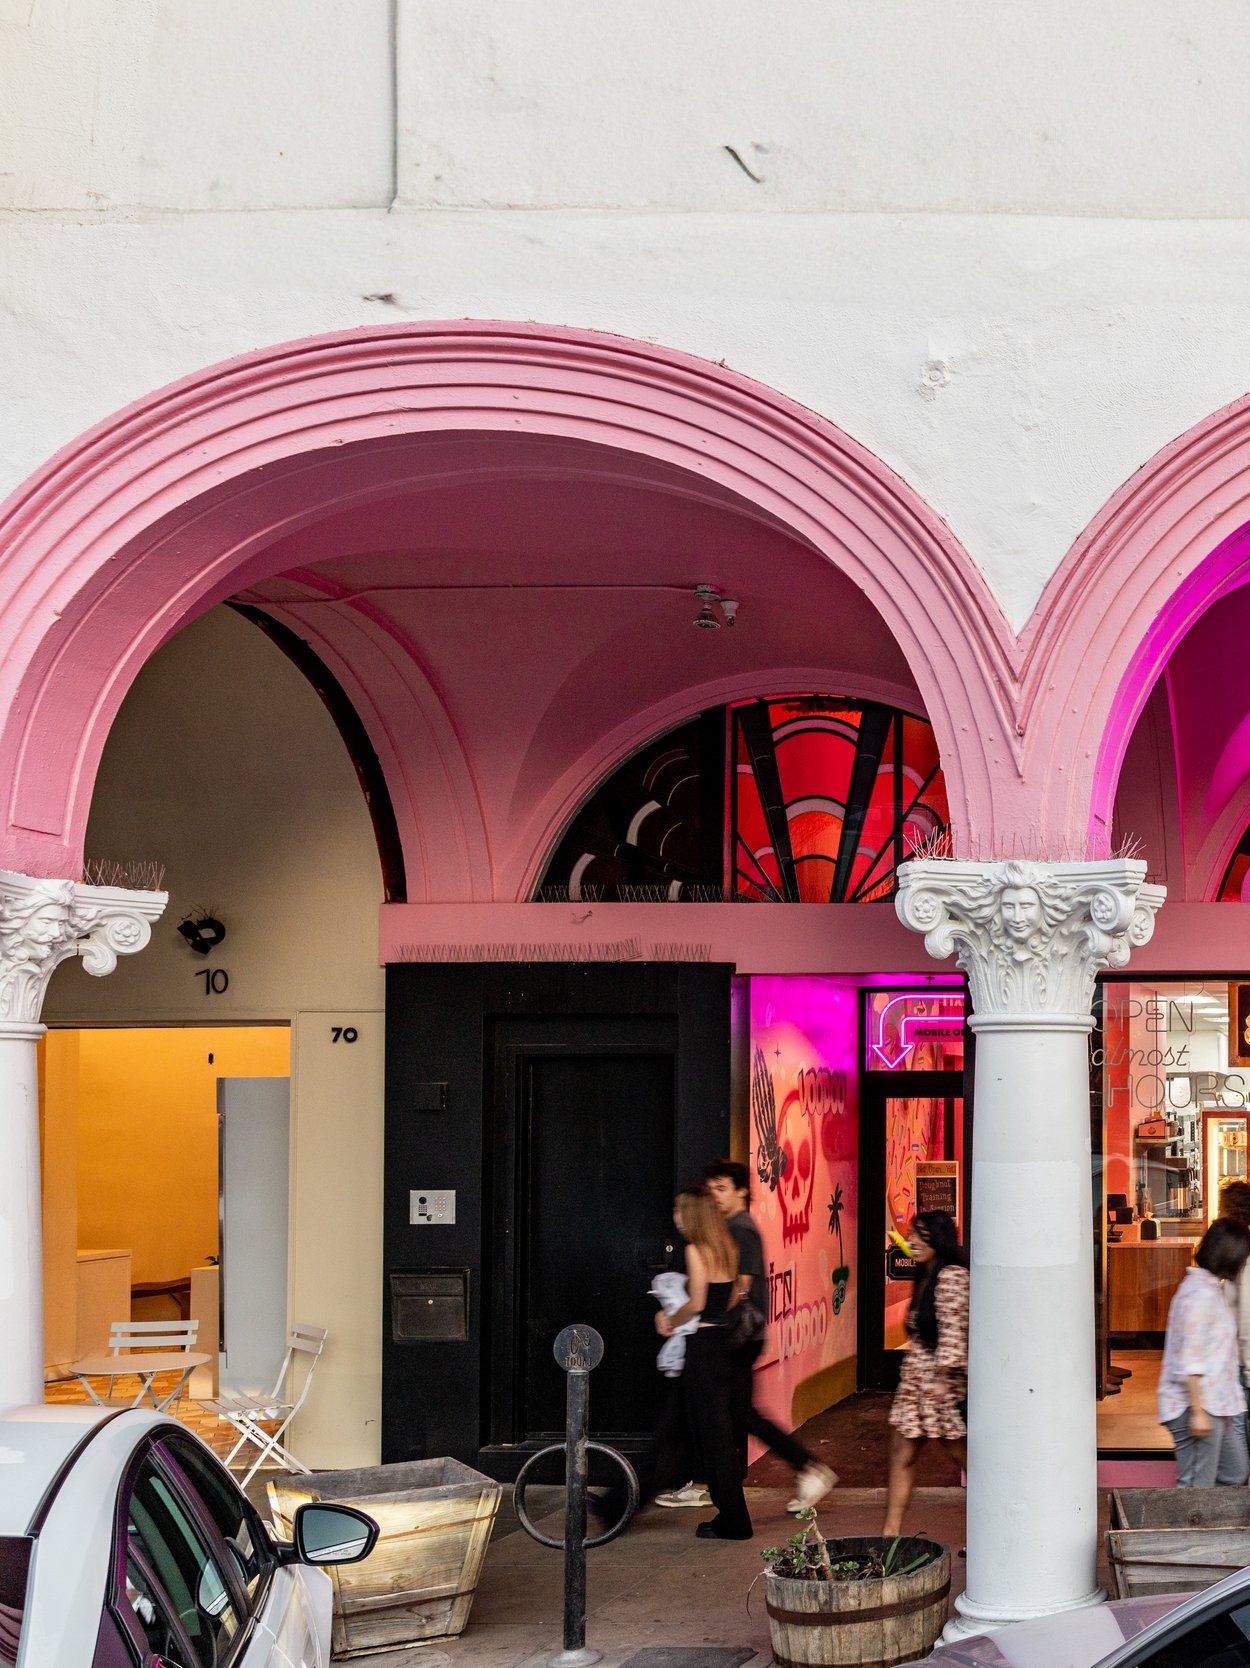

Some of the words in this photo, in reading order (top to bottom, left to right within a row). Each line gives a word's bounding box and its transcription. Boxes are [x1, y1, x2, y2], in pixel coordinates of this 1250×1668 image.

[914, 1028, 951, 1037] MOBILE
[1091, 999, 1194, 1033] OPEN
[331, 1027, 358, 1043] 70
[1091, 1036, 1190, 1067] almost
[797, 1066, 847, 1117] VOODOO
[1107, 1074, 1246, 1108] HOURS
[776, 1296, 828, 1363] VOODOO
